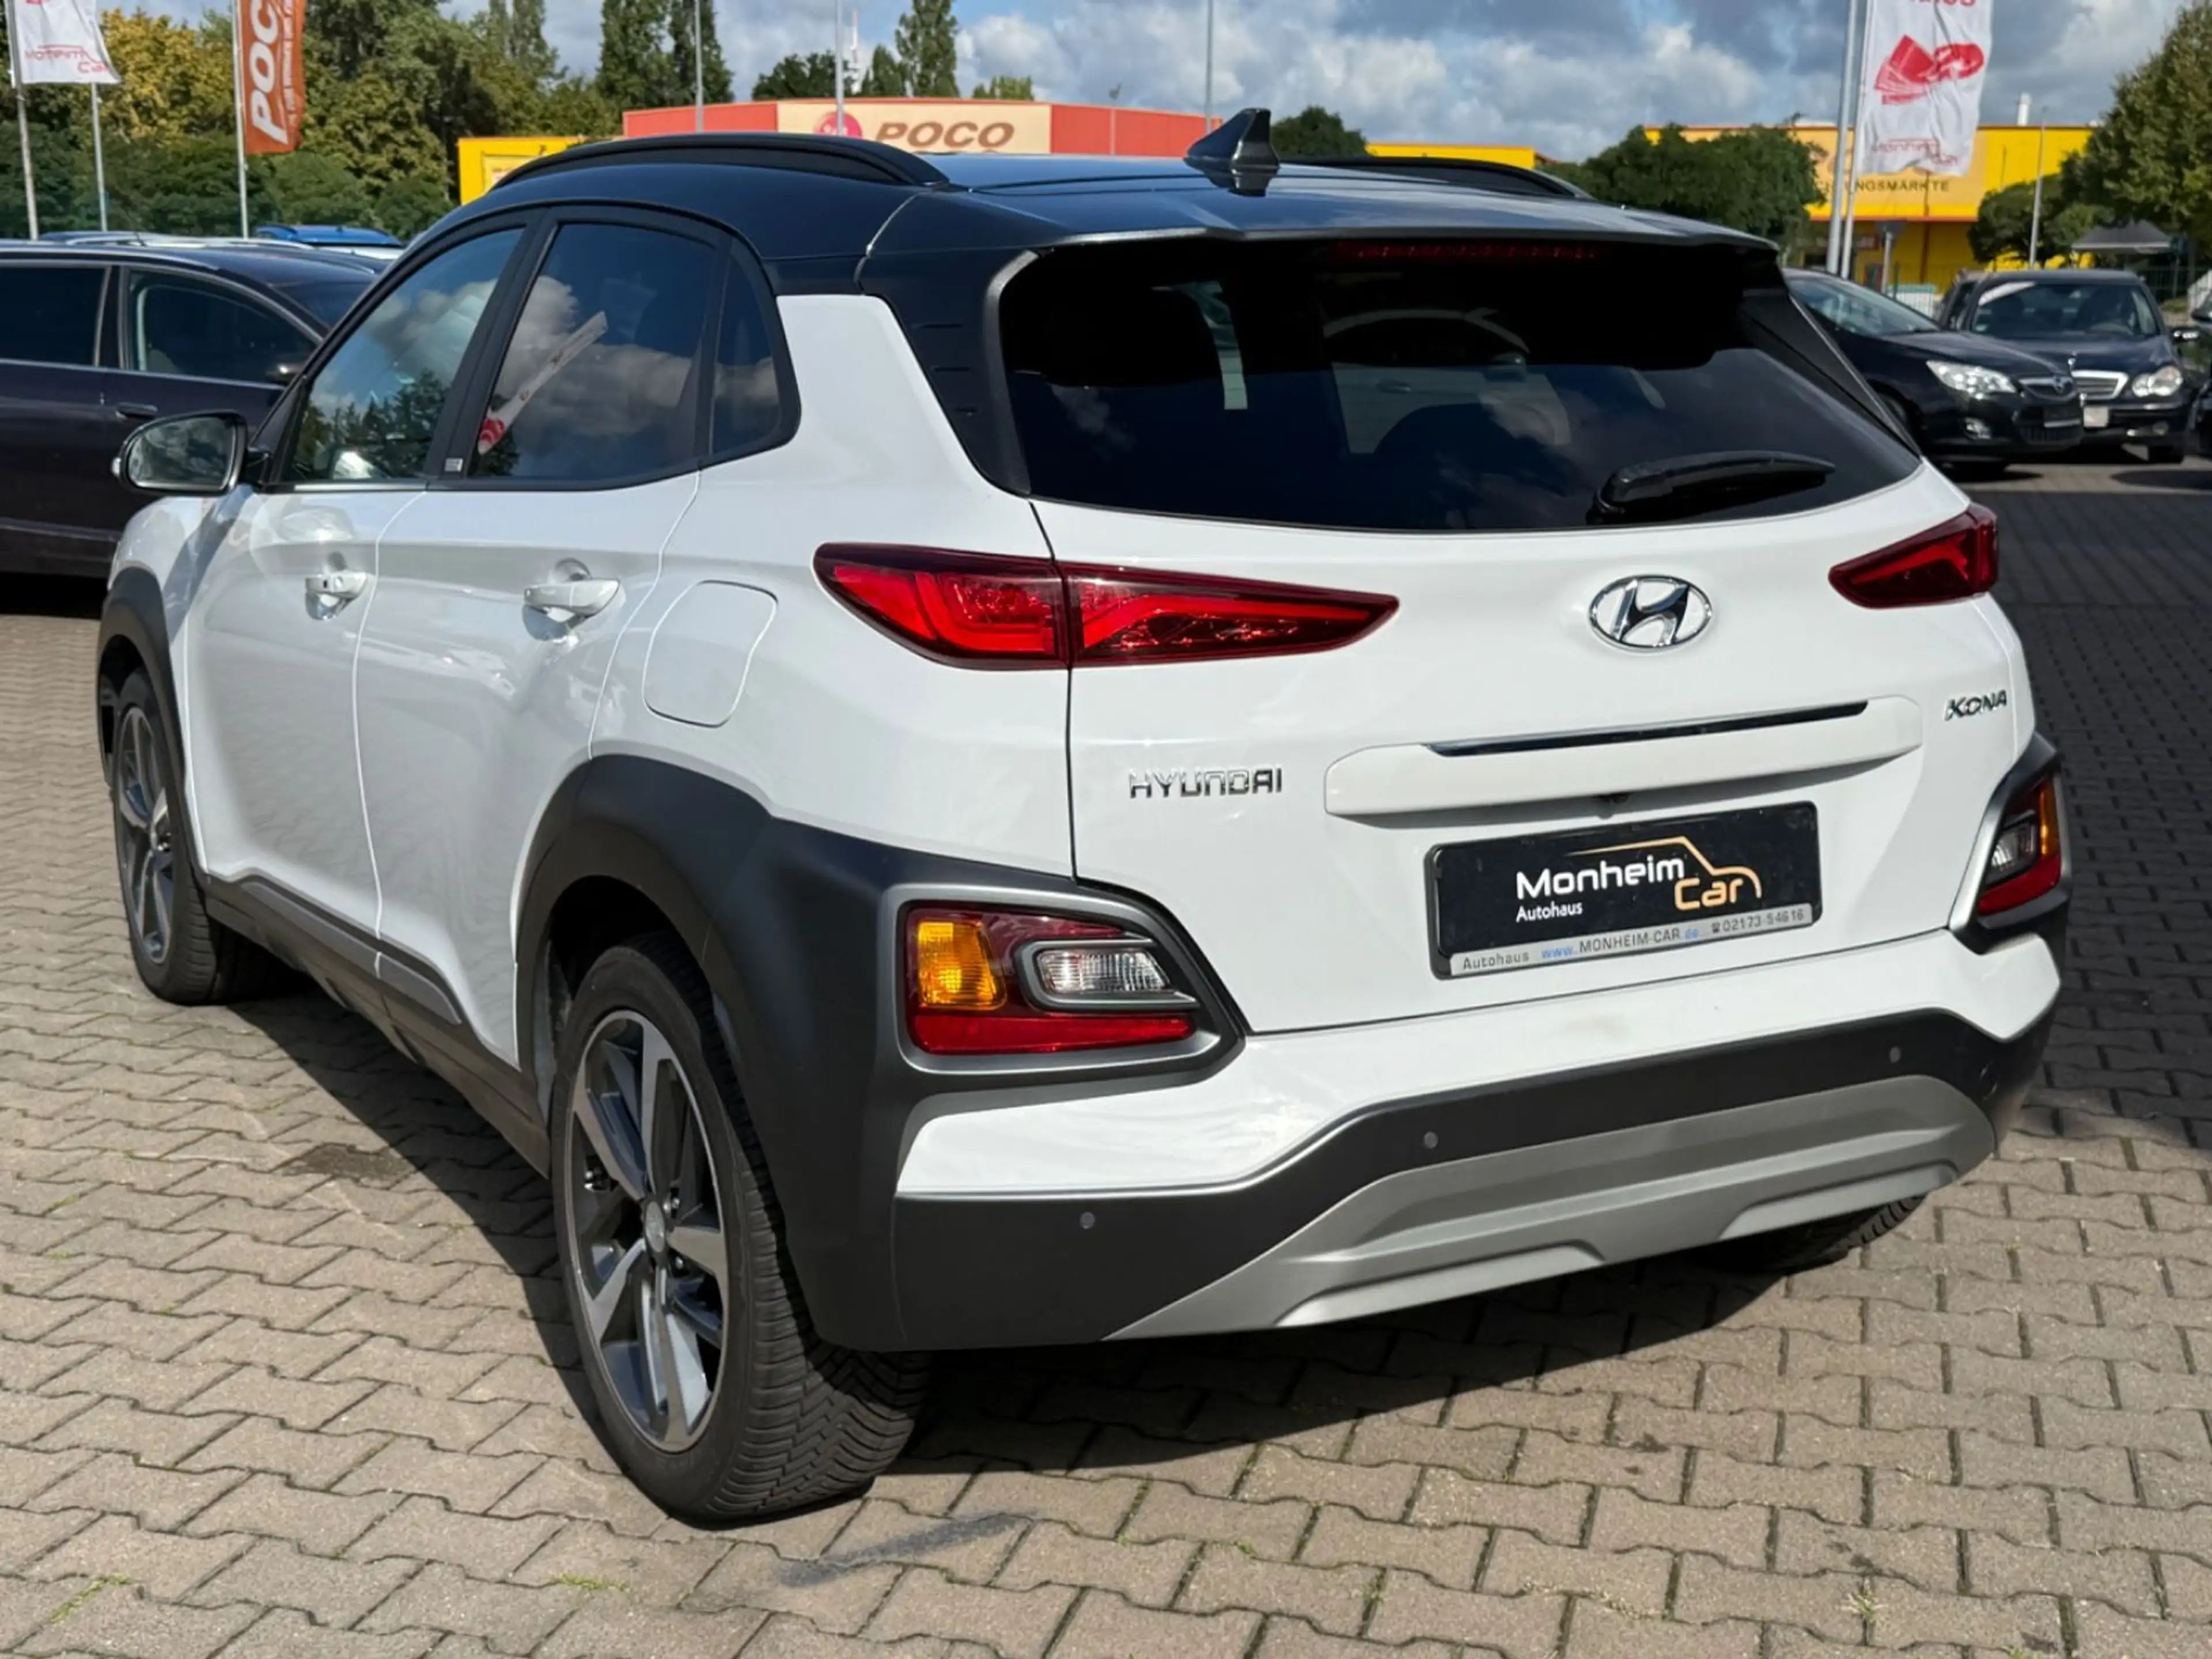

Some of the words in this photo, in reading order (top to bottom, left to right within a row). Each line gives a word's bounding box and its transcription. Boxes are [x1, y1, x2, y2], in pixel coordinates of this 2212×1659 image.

[876, 121, 1015, 148] POCO
[1944, 689, 2008, 721] KONA
[1128, 767, 1282, 798] HYUNDAI
[1516, 855, 1685, 900] Monheim
[1674, 877, 1744, 911] Car
[1515, 900, 1584, 923] Autohaus
[1462, 952, 1530, 971] Autohaus
